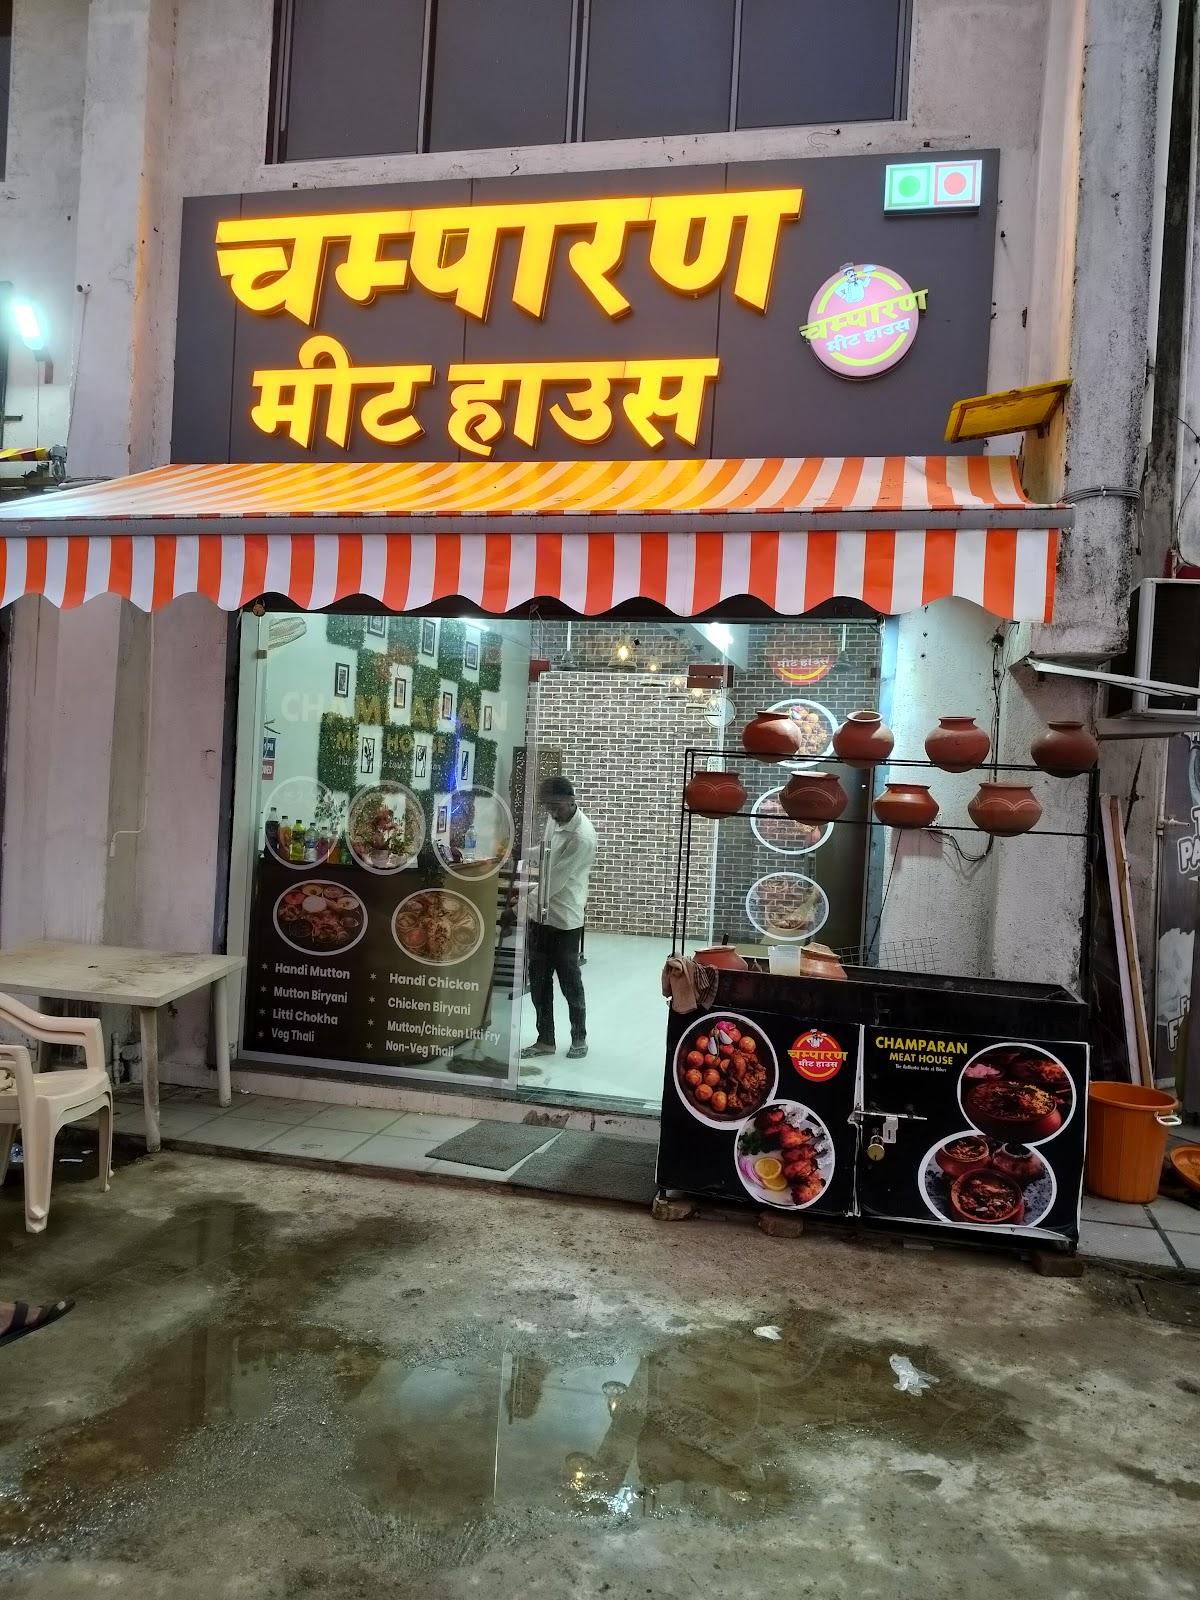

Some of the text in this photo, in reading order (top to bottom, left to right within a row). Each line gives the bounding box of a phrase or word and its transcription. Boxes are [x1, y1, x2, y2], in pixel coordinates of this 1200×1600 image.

[215, 188, 803, 327] चम्पारण
[799, 288, 929, 341] चम्पारण
[826, 318, 911, 352] मीट हाउस
[252, 334, 721, 456] मीट हाउस
[275, 963, 350, 980] Handi Mutton
[389, 973, 479, 992] Handi Chicken
[274, 986, 348, 1005] Mutton Biryani
[272, 1008, 338, 1025] Litti Chokha
[388, 997, 471, 1017] Chicken Biryani
[271, 1027, 315, 1043] Veg Thali
[387, 1020, 501, 1046] Mutton/Chicken Litti Fry
[386, 1040, 454, 1058] Non-Veg Thali
[787, 1049, 849, 1061] चम्पारण
[875, 1036, 968, 1055] CHAMPARAN
[798, 1059, 815, 1068] मीट
[888, 1051, 953, 1065] MEAT HOUSE
